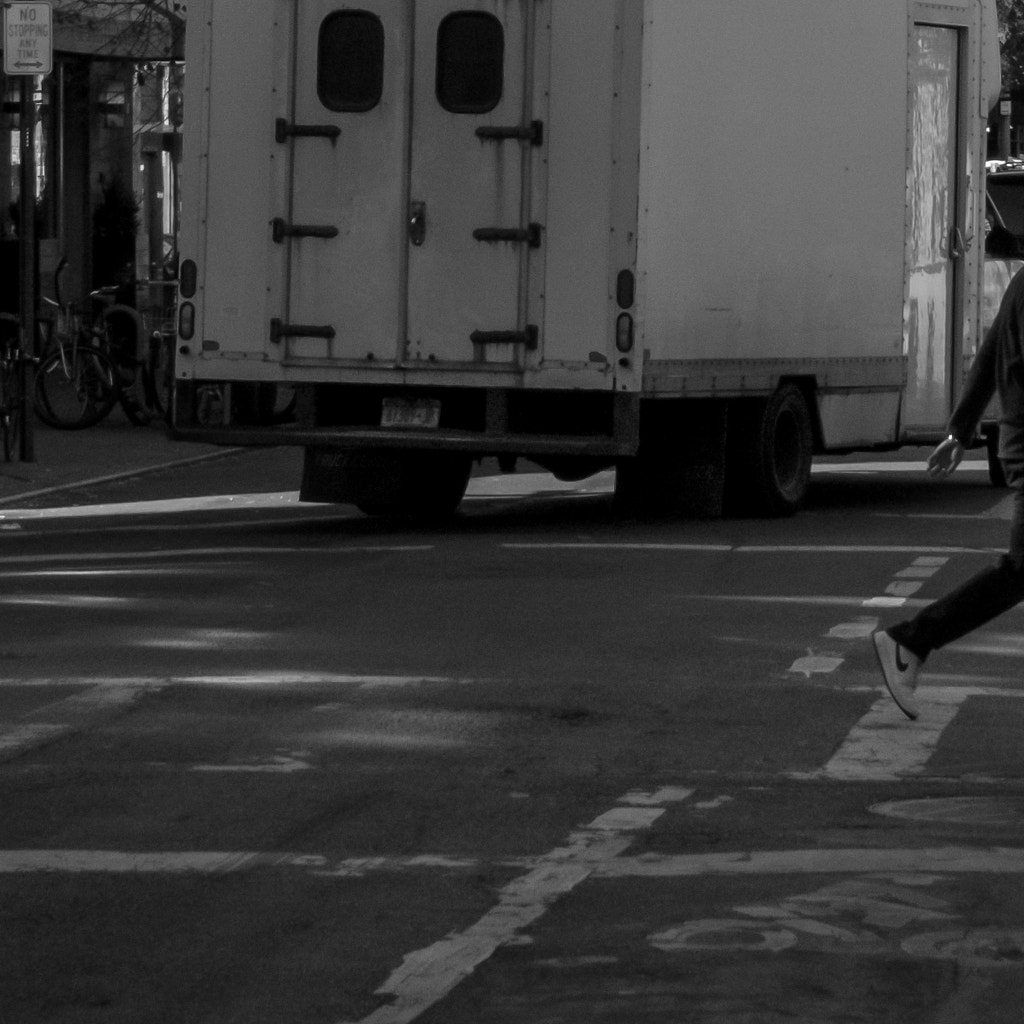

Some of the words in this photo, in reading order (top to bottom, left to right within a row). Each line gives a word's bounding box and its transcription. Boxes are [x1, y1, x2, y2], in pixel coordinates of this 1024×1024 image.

[20, 8, 37, 21] NO
[8, 24, 49, 37] STOPPING
[20, 39, 37, 49] ANY
[17, 49, 40, 59] TIME
